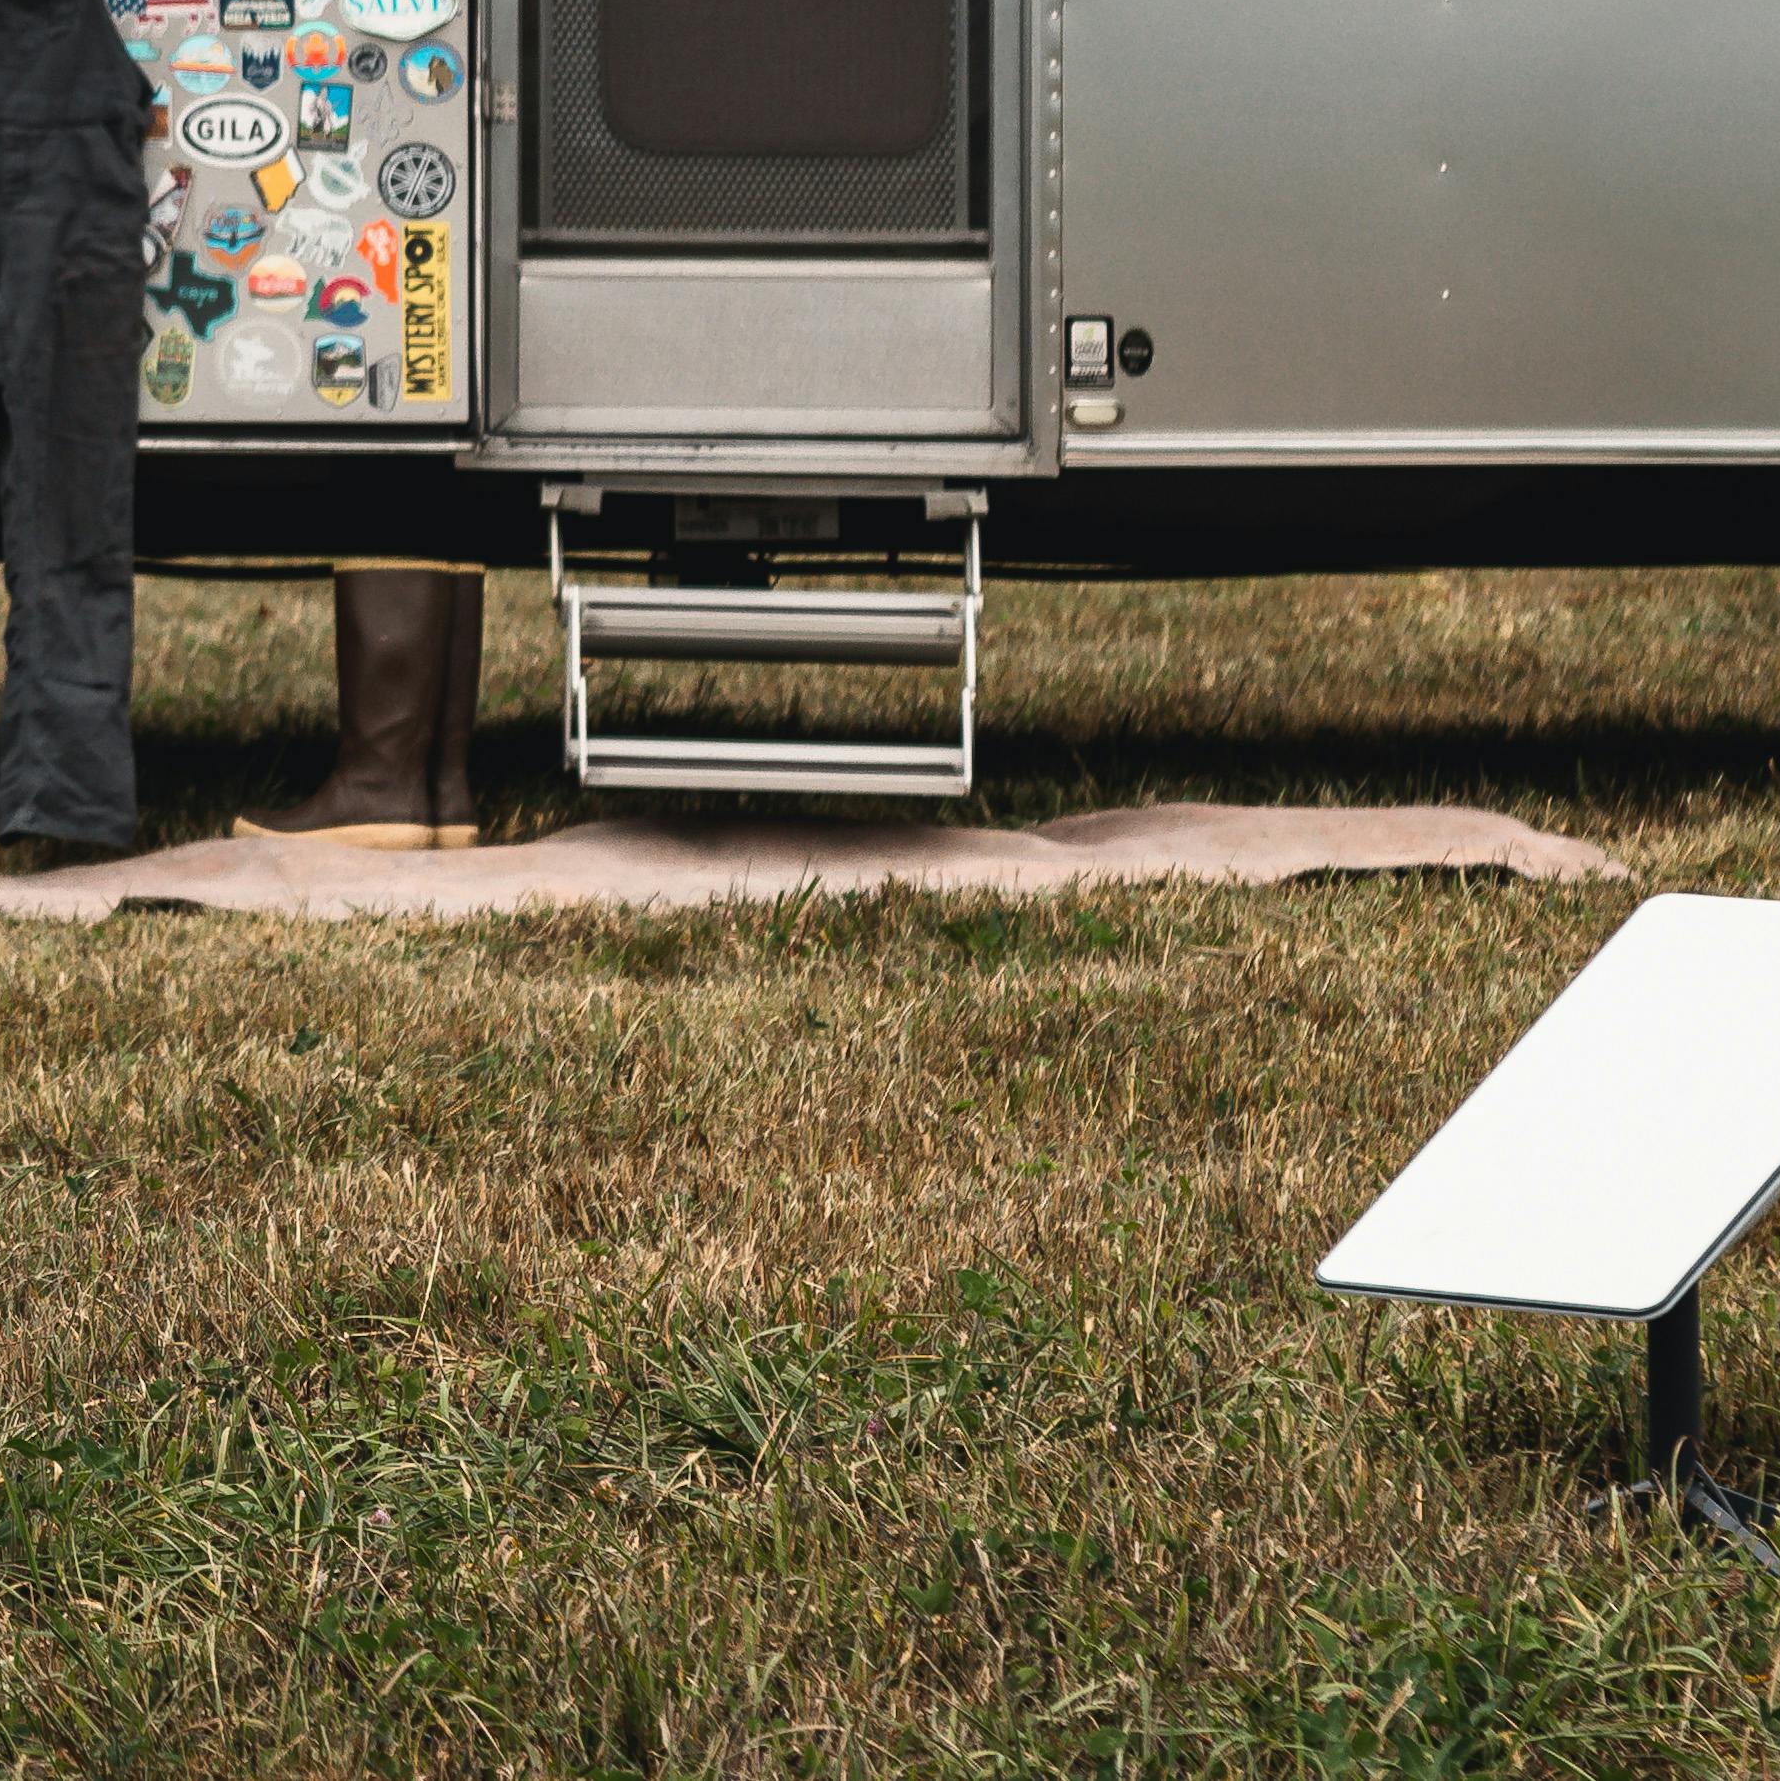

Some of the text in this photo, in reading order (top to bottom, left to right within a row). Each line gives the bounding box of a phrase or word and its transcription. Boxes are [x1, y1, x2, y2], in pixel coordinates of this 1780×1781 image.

[197, 119, 266, 141] GILA
[404, 223, 436, 395] MYSTERY SPOT
